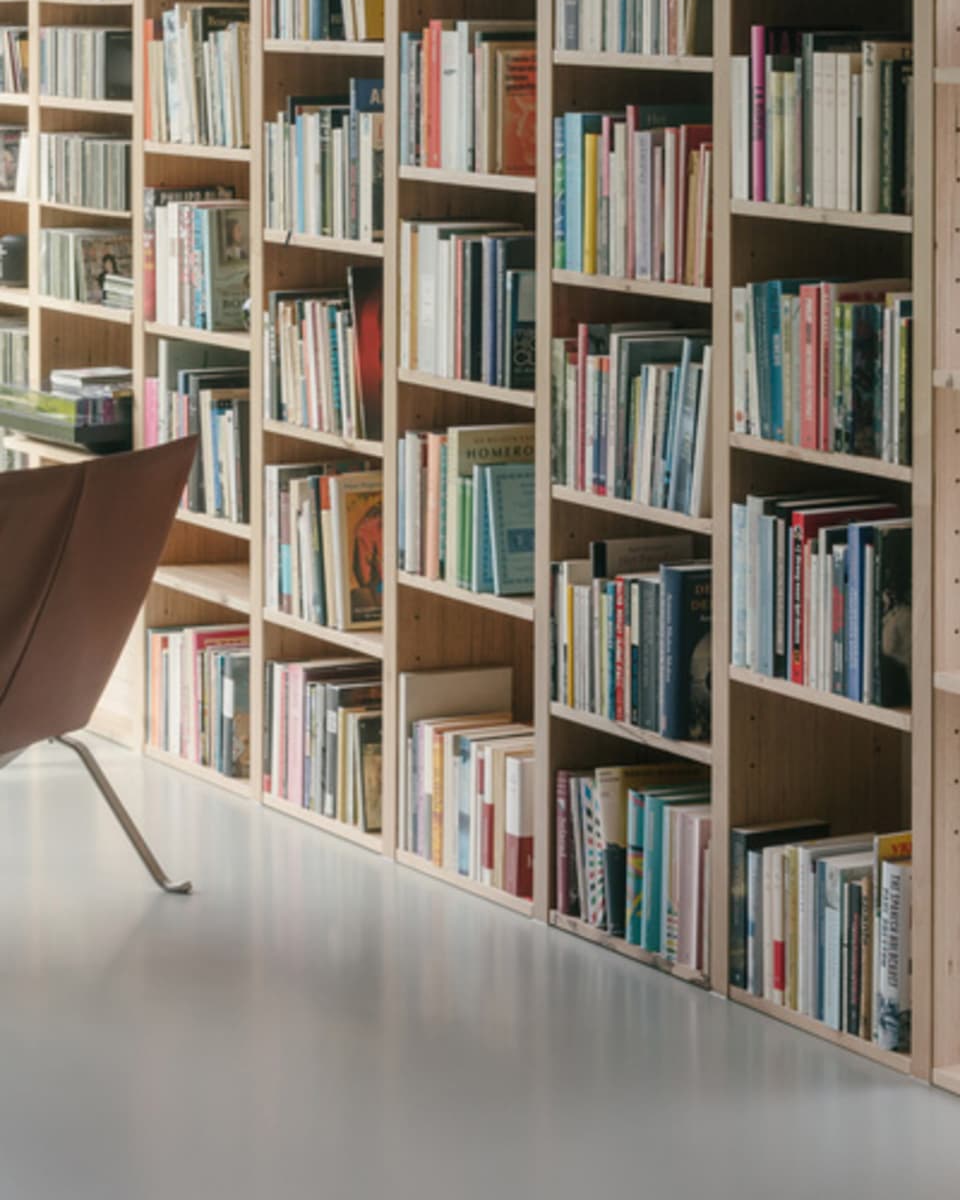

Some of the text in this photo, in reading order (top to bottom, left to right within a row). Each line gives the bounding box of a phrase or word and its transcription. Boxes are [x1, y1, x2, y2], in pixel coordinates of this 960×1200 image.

[465, 446, 535, 459] HOMERO
[888, 874, 900, 989] THE SPANISH HOLOCAUST
